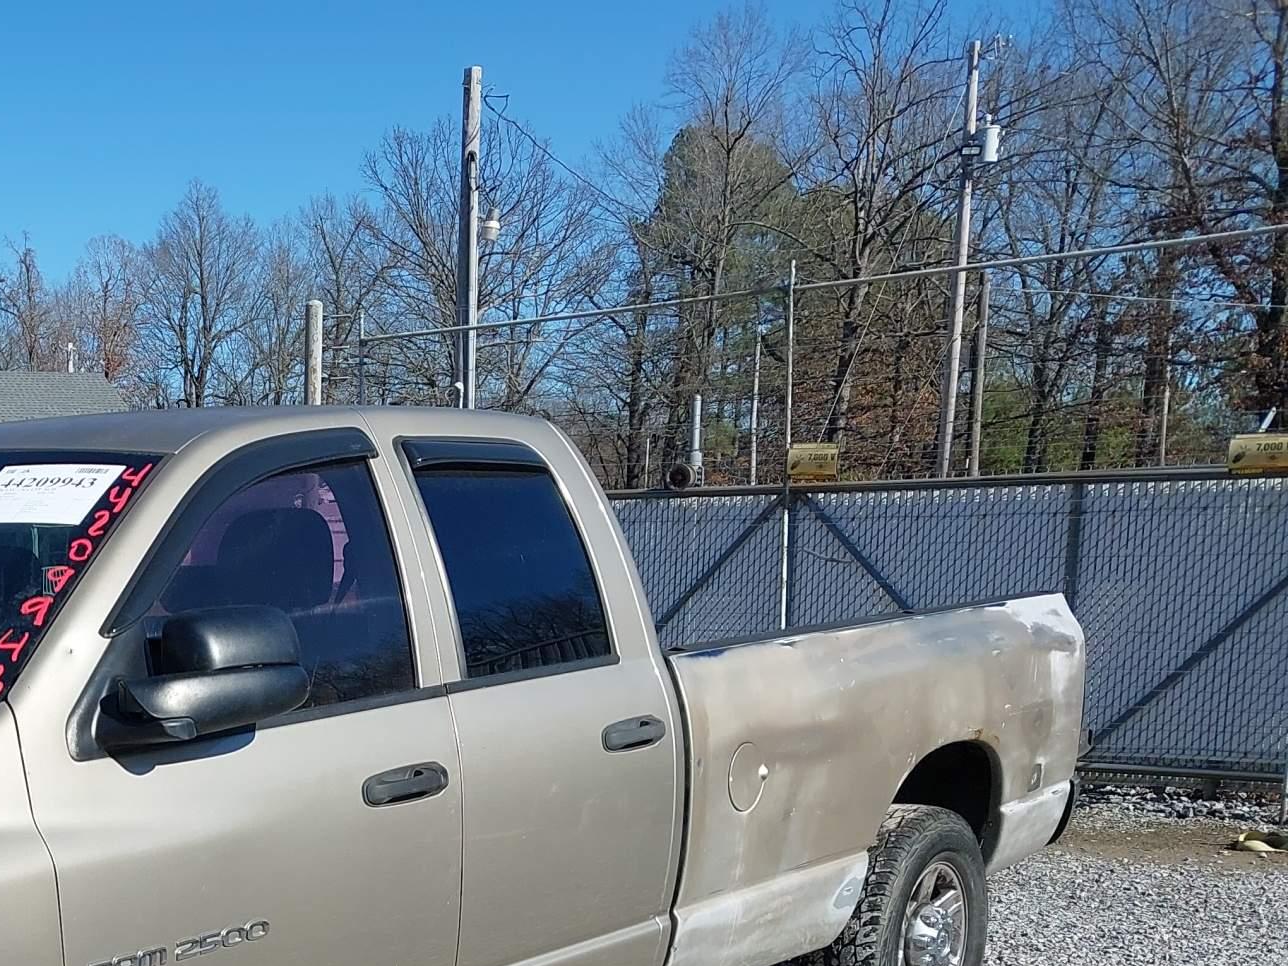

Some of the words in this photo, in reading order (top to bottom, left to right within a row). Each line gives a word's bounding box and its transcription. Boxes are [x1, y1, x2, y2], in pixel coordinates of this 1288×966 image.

[1256, 442, 1284, 452] 7,000
[0, 477, 99, 489] 44209943
[175, 919, 271, 961] 2500
